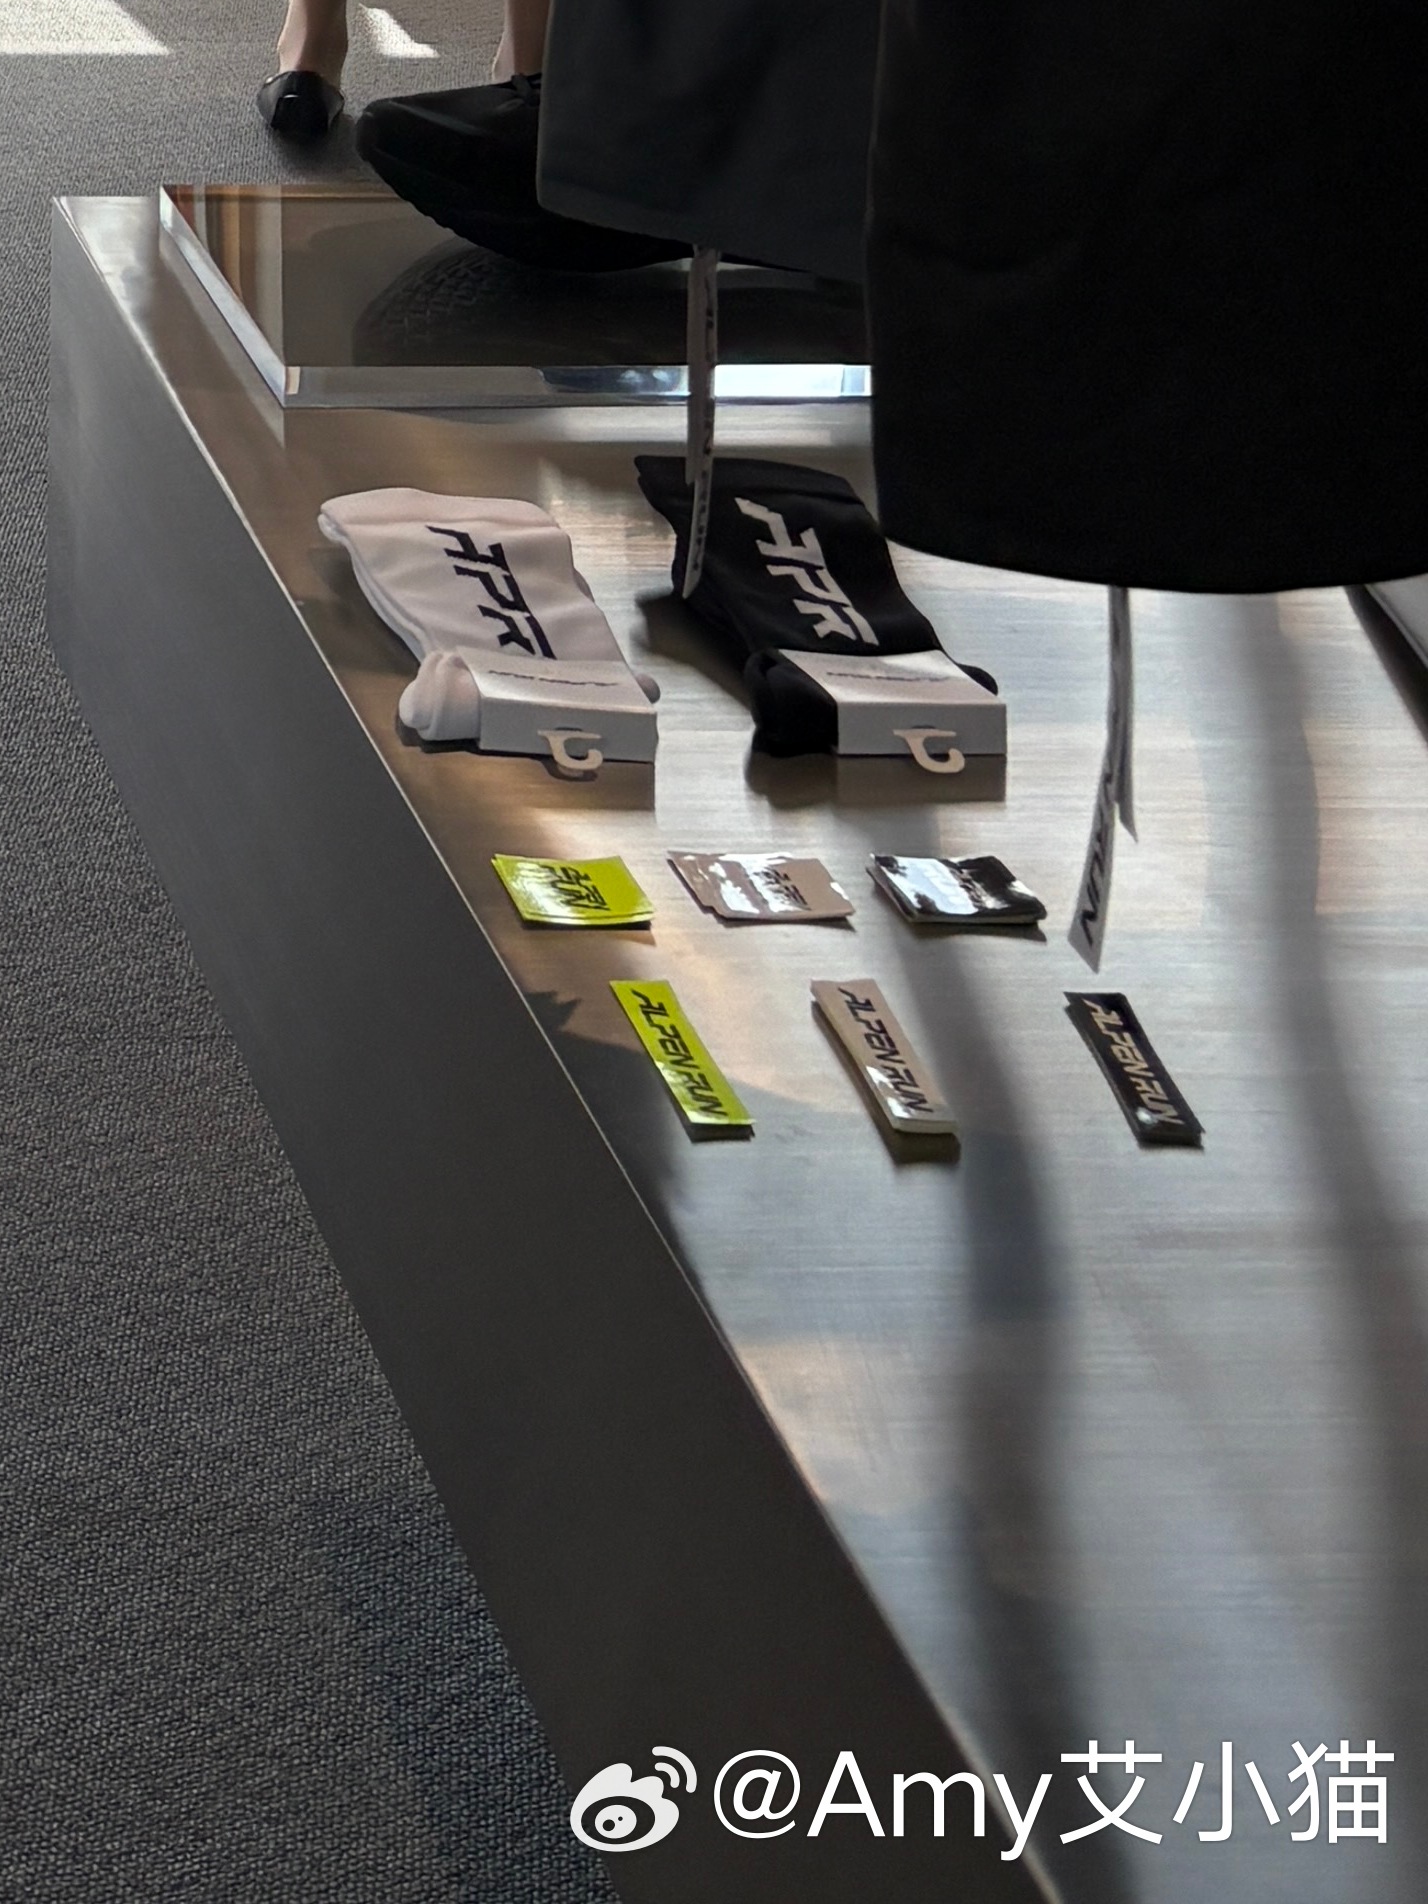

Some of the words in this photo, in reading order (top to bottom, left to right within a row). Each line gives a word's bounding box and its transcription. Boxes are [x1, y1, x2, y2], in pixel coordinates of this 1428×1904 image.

[631, 989, 700, 1070] ALPEN
[675, 1070, 728, 1117] RUN
[838, 987, 906, 1065] ALPEN
[880, 1064, 934, 1113] RUN
[1082, 998, 1155, 1078] ALPEN
